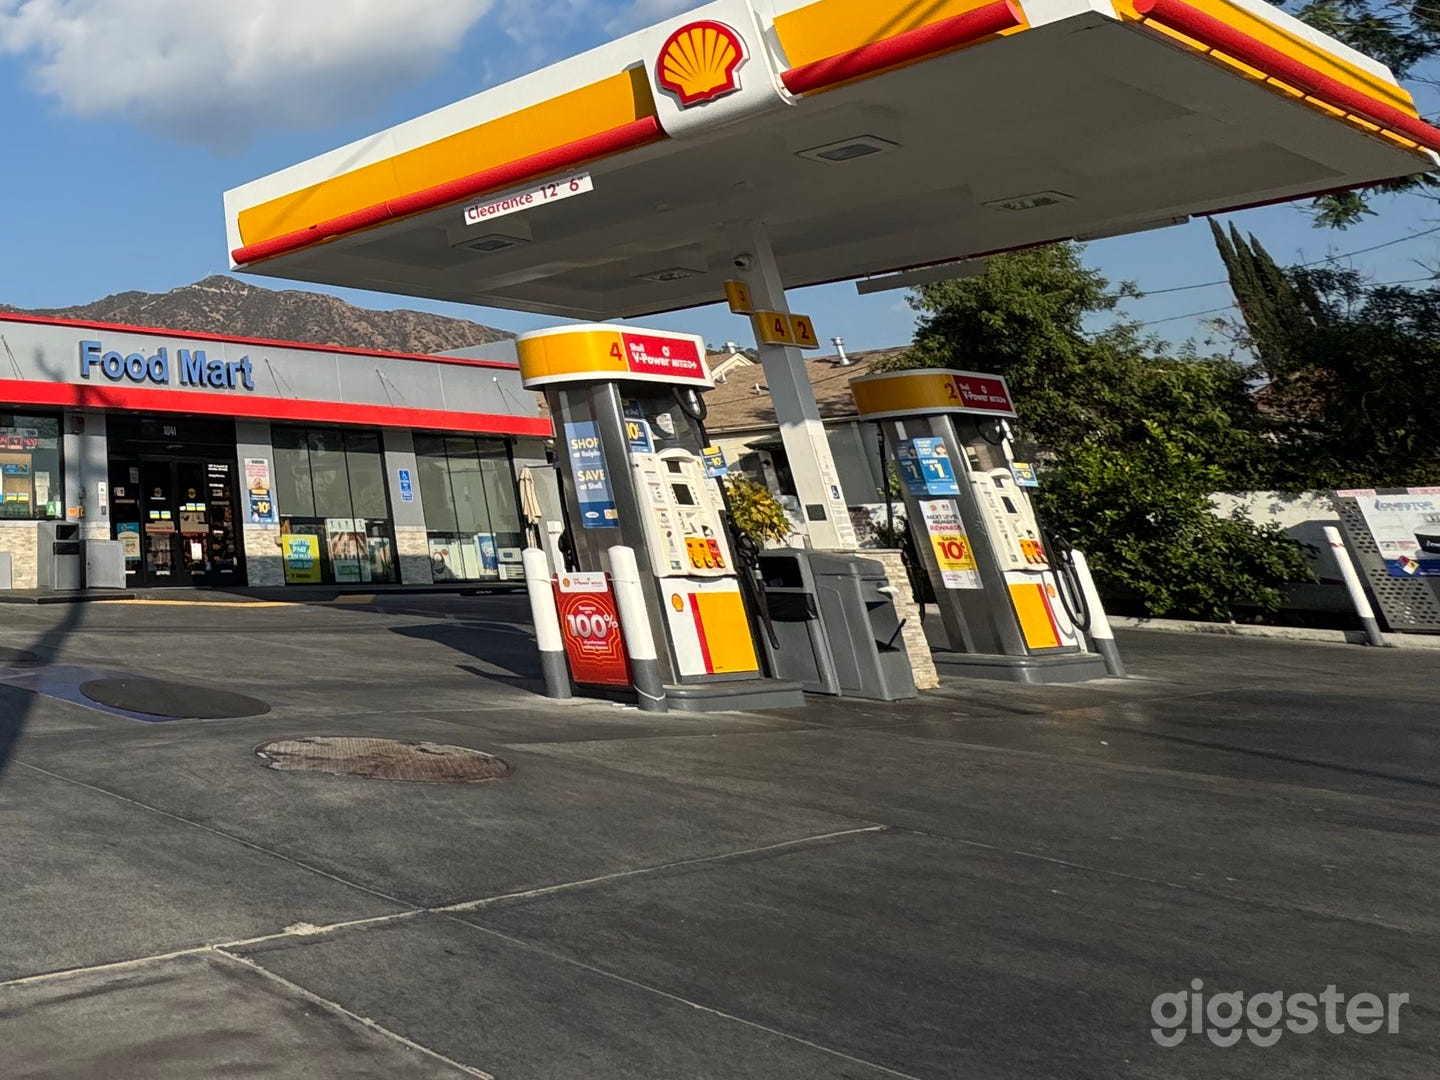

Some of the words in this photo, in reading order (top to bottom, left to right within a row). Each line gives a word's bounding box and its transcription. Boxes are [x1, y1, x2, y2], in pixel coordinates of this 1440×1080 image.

[468, 193, 534, 220] Clearance
[738, 290, 746, 301] 3
[774, 318, 785, 337] 4
[797, 321, 809, 340] 2
[609, 342, 623, 361] 4
[632, 352, 671, 366] V-Power
[80, 340, 170, 386] Food
[178, 348, 255, 391] Mart
[944, 382, 959, 399] 2
[570, 437, 600, 450] SHOP
[577, 469, 606, 481] SAVE
[567, 613, 619, 638] 100%
